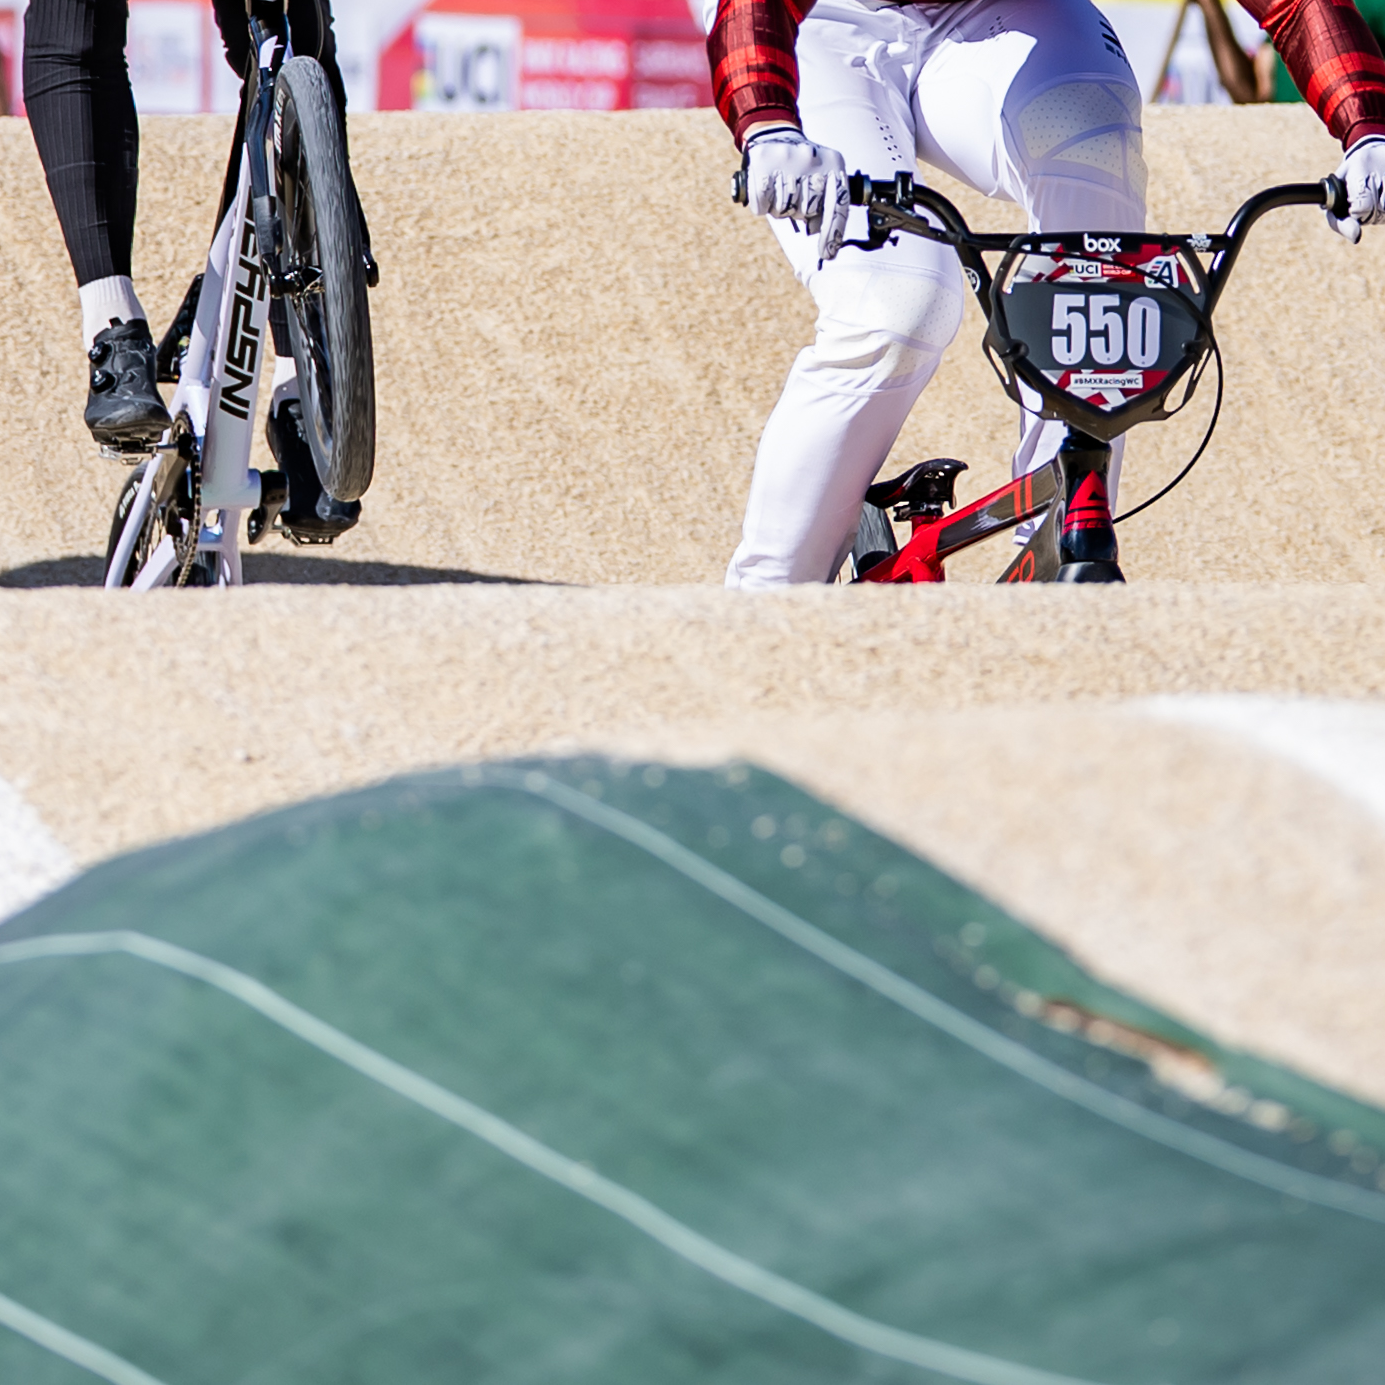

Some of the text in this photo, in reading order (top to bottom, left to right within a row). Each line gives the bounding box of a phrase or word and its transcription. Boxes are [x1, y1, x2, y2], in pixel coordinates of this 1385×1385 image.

[1083, 233, 1122, 253] box
[1075, 264, 1099, 274] UCI
[1153, 261, 1175, 285] A
[1051, 293, 1161, 368] 550
[1073, 376, 1140, 388] #BMXRacingWC
